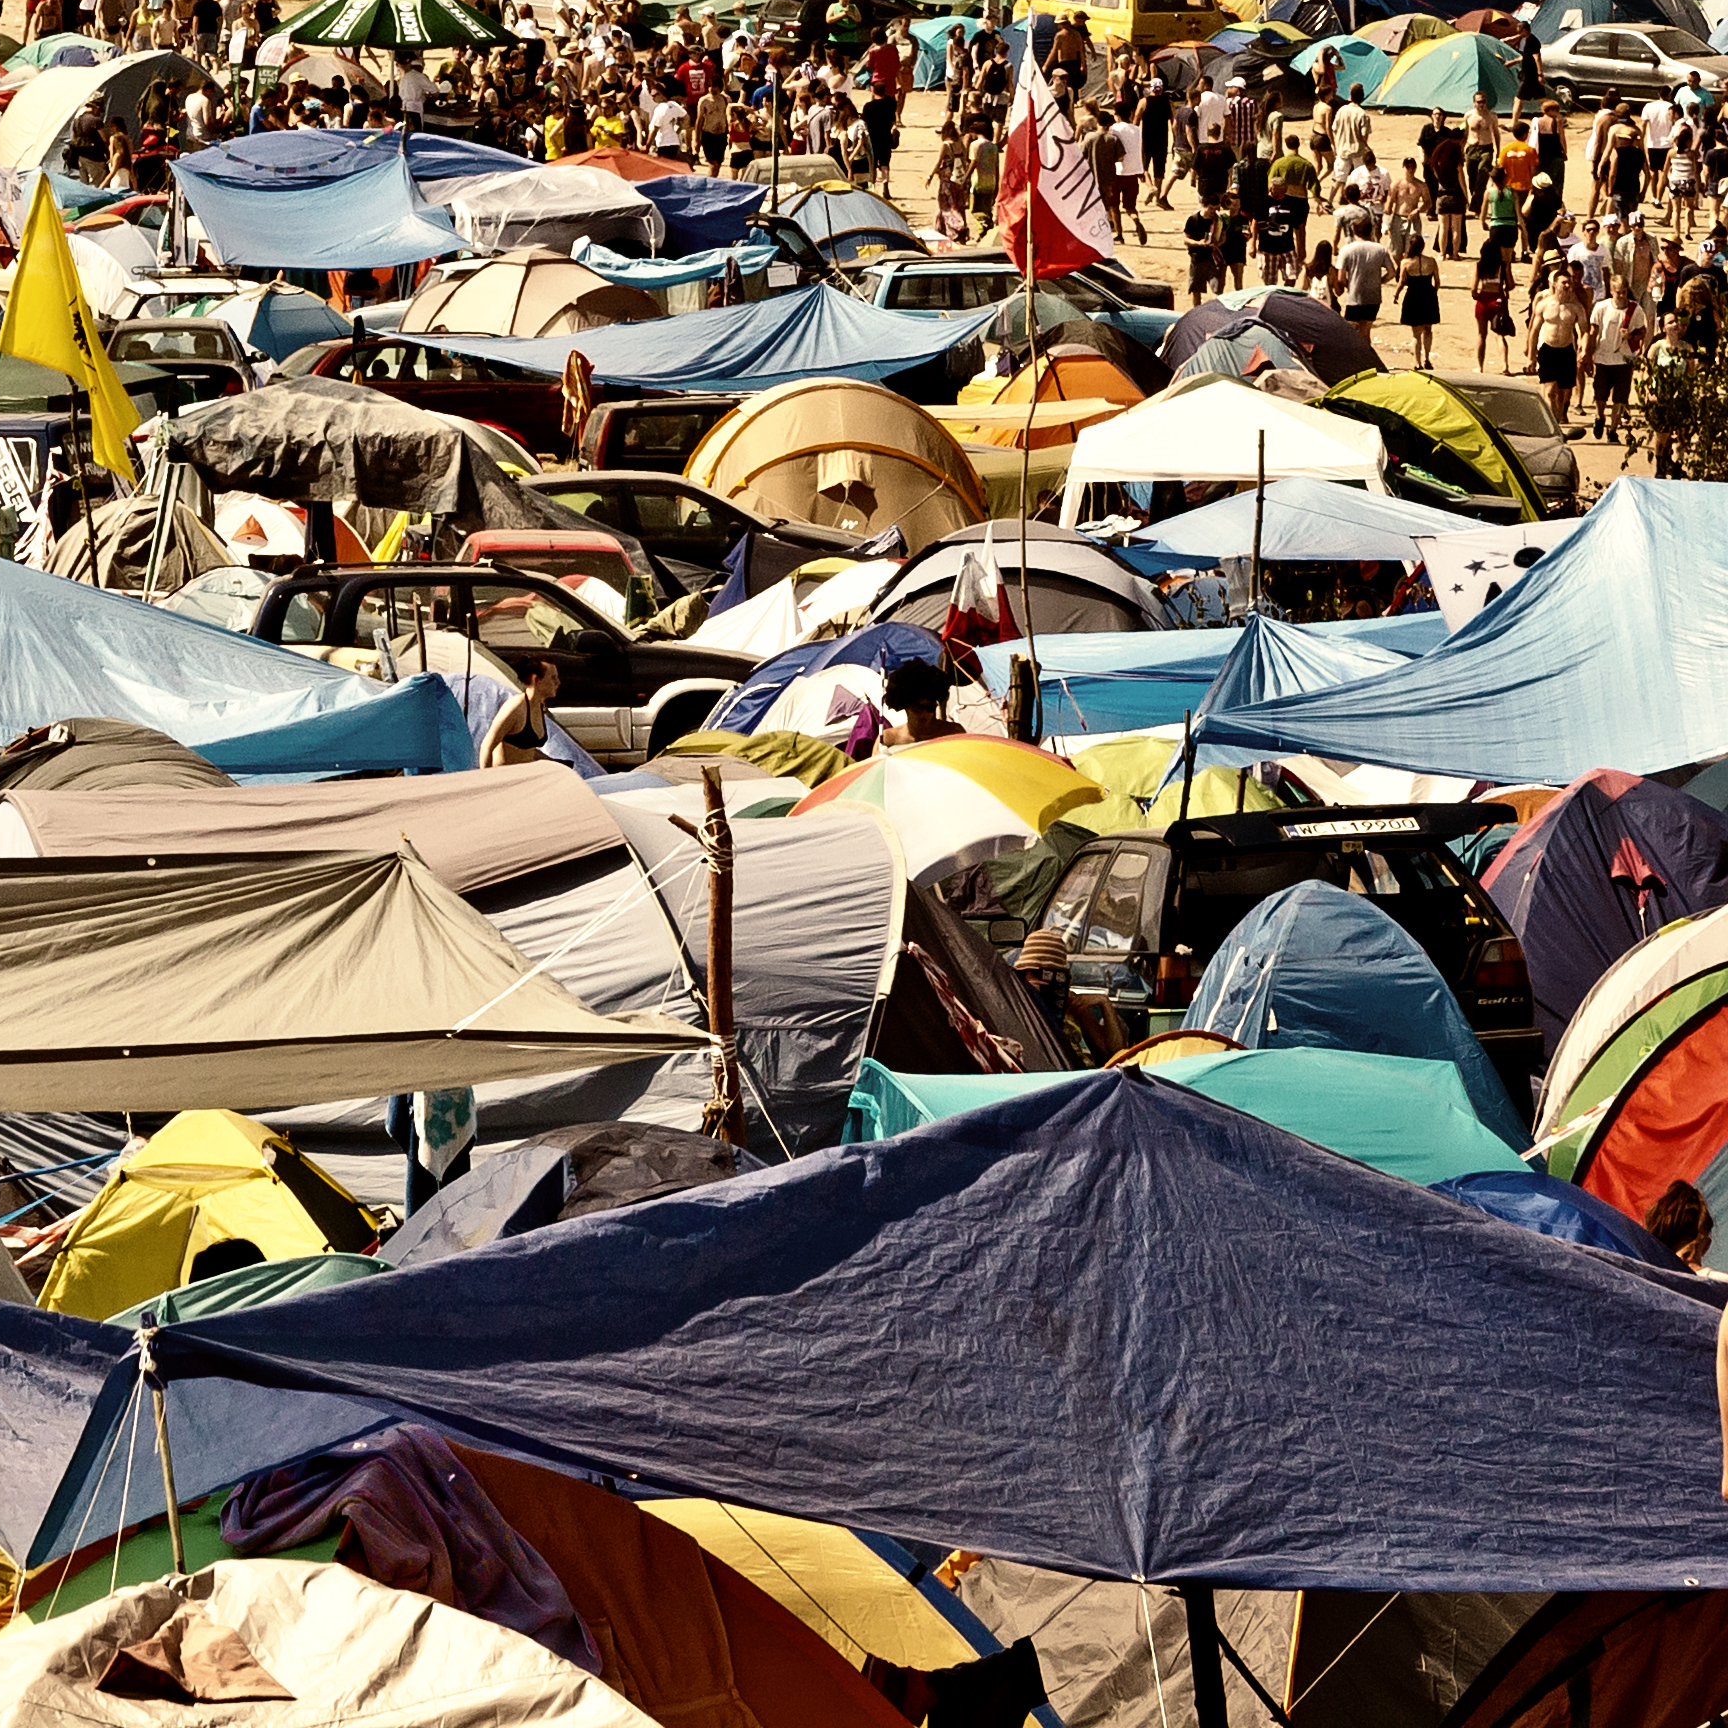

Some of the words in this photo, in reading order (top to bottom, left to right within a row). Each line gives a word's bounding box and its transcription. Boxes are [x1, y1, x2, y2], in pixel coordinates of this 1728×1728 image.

[399, 8, 422, 42] LECH
[1299, 821, 1336, 836] WCI
[1348, 817, 1416, 834] 19900
[1477, 996, 1509, 1007] Golf
